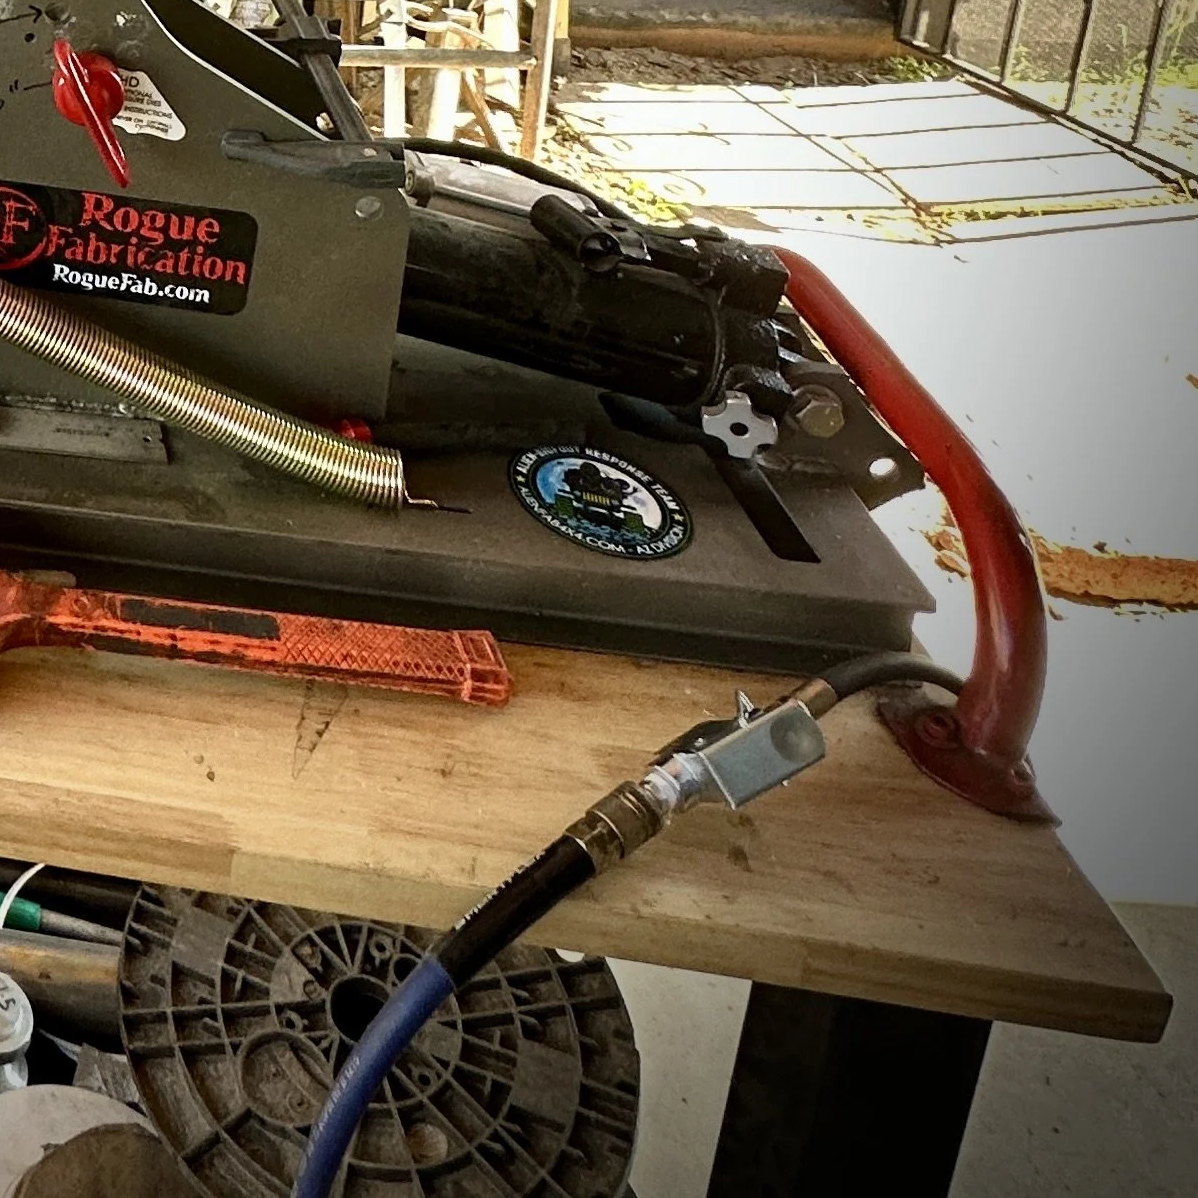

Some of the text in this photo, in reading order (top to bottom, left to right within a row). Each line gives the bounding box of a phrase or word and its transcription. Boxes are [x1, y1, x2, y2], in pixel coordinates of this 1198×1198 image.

[80, 192, 220, 245] Rogue
[44, 224, 246, 285] Fabrication
[52, 263, 211, 303] RogueFab.com
[585, 448, 652, 483] RESPONSE
[652, 484, 680, 511] TEAM
[654, 523, 685, 553] DIVISION
